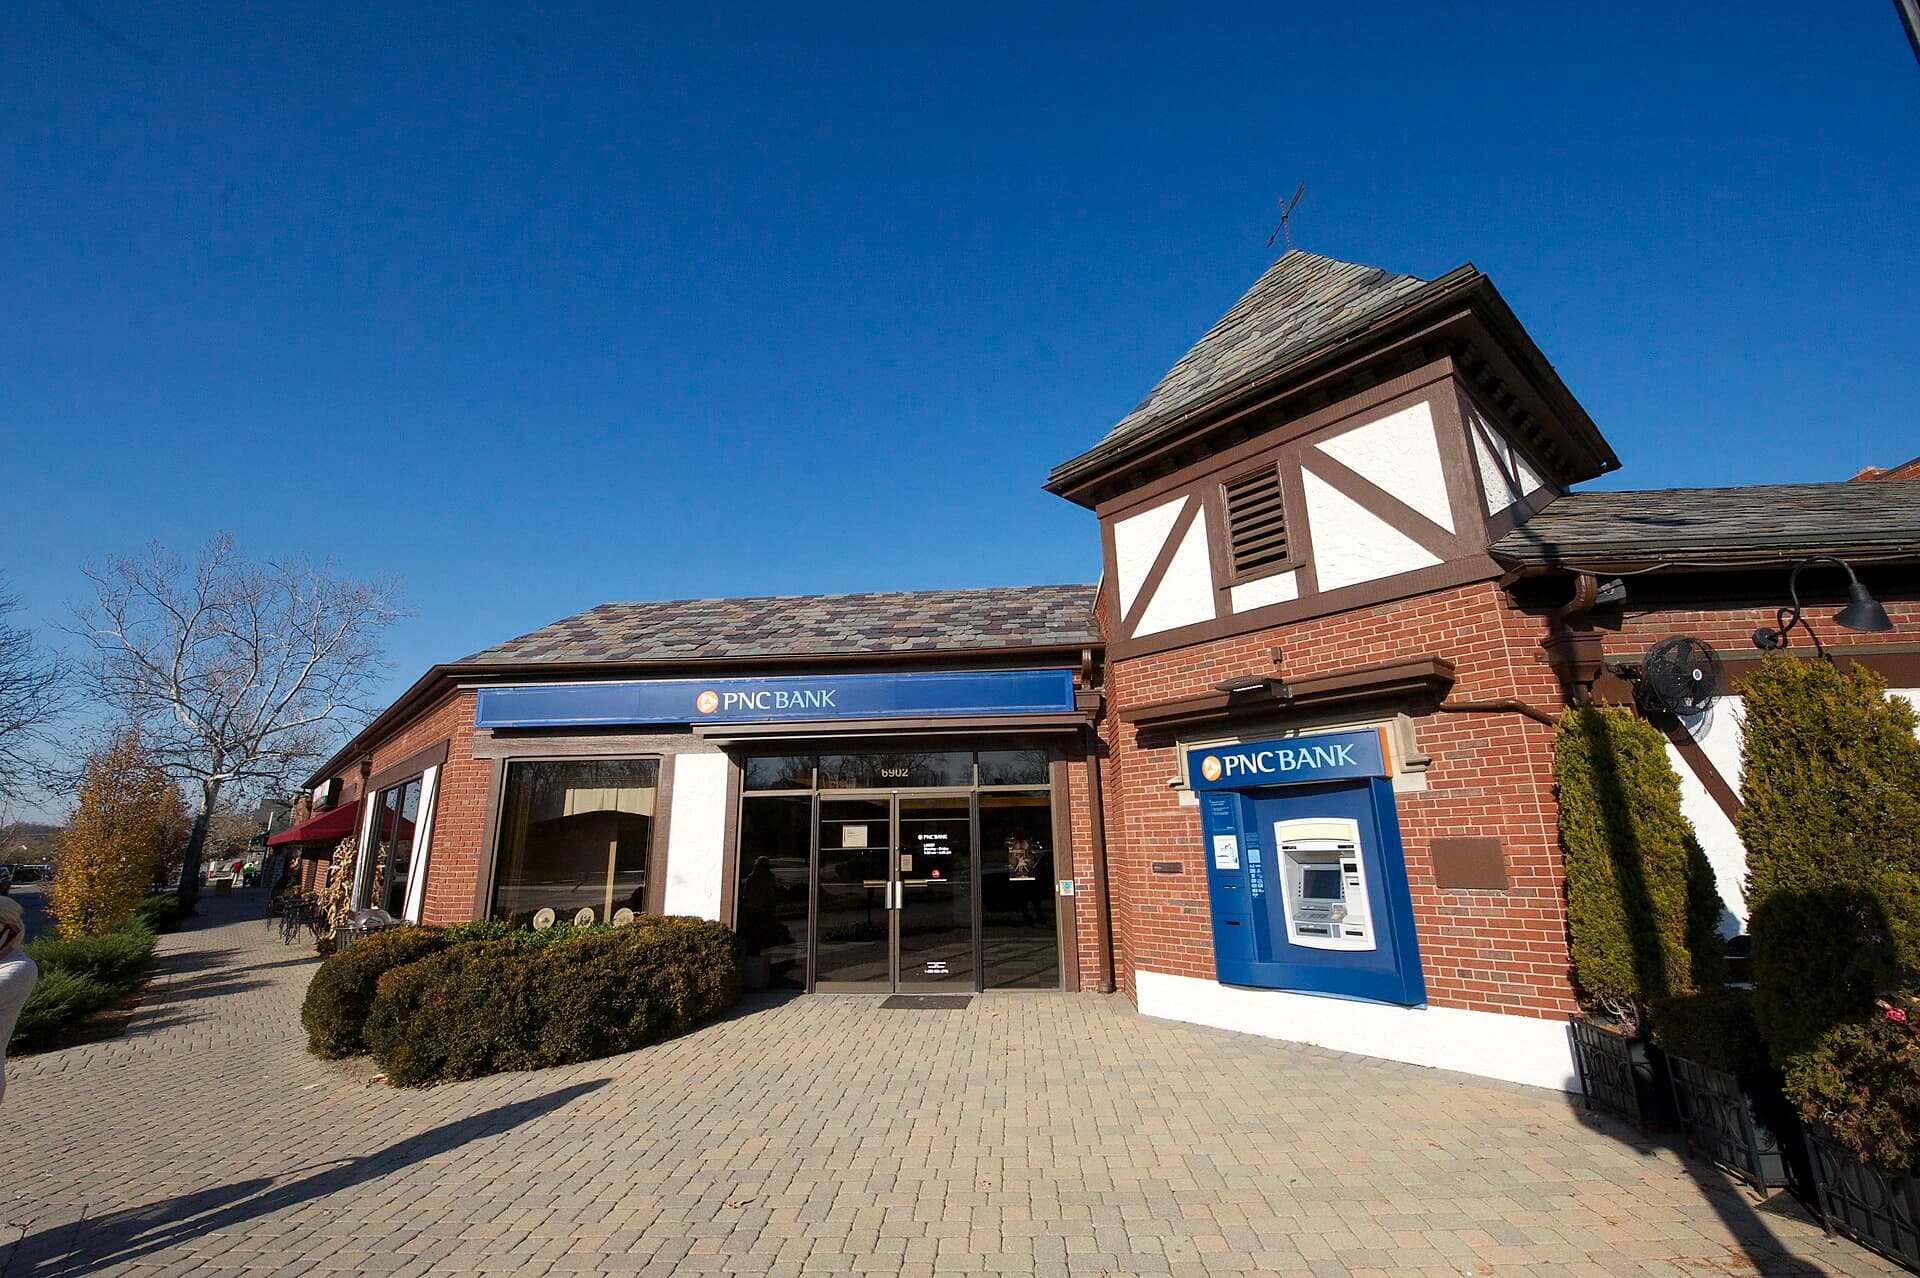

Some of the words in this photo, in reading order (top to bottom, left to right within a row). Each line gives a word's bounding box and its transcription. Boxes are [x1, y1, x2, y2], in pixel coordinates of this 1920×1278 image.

[722, 691, 771, 710] PNC
[773, 690, 836, 709] BANK
[1222, 751, 1276, 776] PNC
[1275, 743, 1358, 771] BANK
[881, 768, 909, 778] 6902
